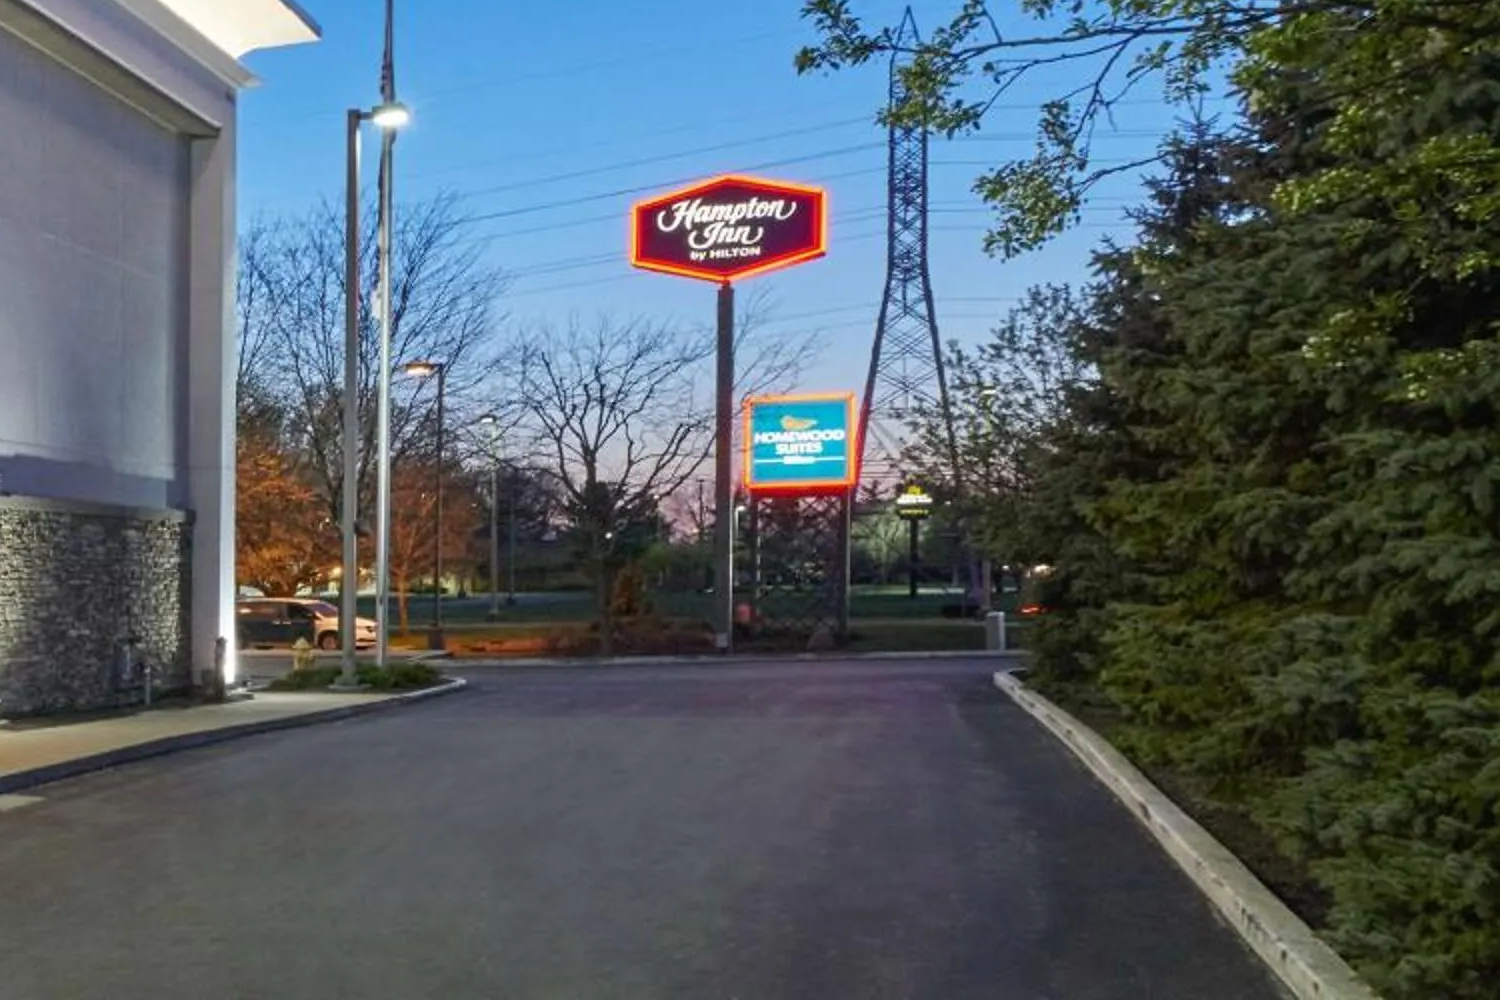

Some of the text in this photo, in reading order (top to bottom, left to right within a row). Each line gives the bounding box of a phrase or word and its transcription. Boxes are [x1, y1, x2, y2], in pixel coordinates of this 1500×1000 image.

[657, 197, 797, 232] Hampton
[688, 221, 764, 249] Inn
[709, 246, 761, 259] HILTON
[754, 430, 845, 444] HOMEWOOD
[775, 442, 823, 455] SUITES
